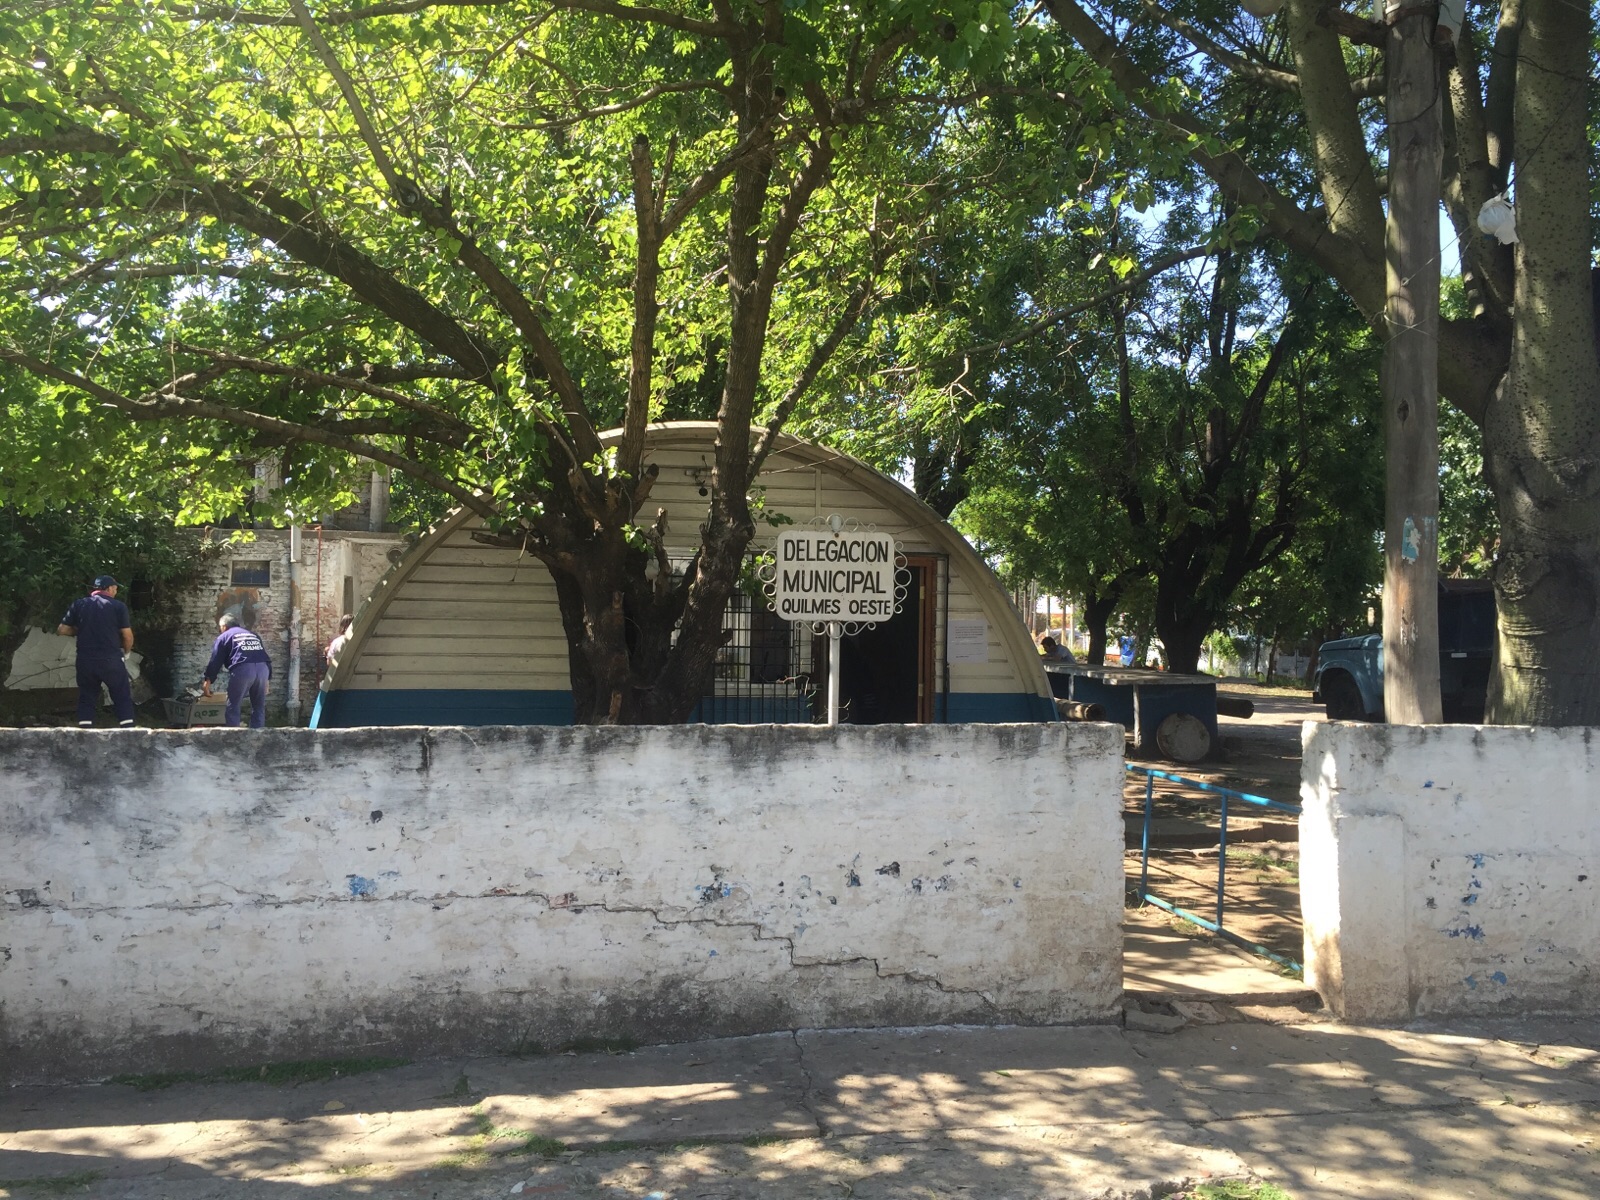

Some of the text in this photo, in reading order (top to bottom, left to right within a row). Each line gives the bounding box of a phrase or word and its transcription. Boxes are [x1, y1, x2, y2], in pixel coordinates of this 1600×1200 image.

[783, 539, 888, 562] DELEGACION
[783, 569, 886, 593] MUNICIPAL
[781, 598, 891, 615] QUILMES OESTE
